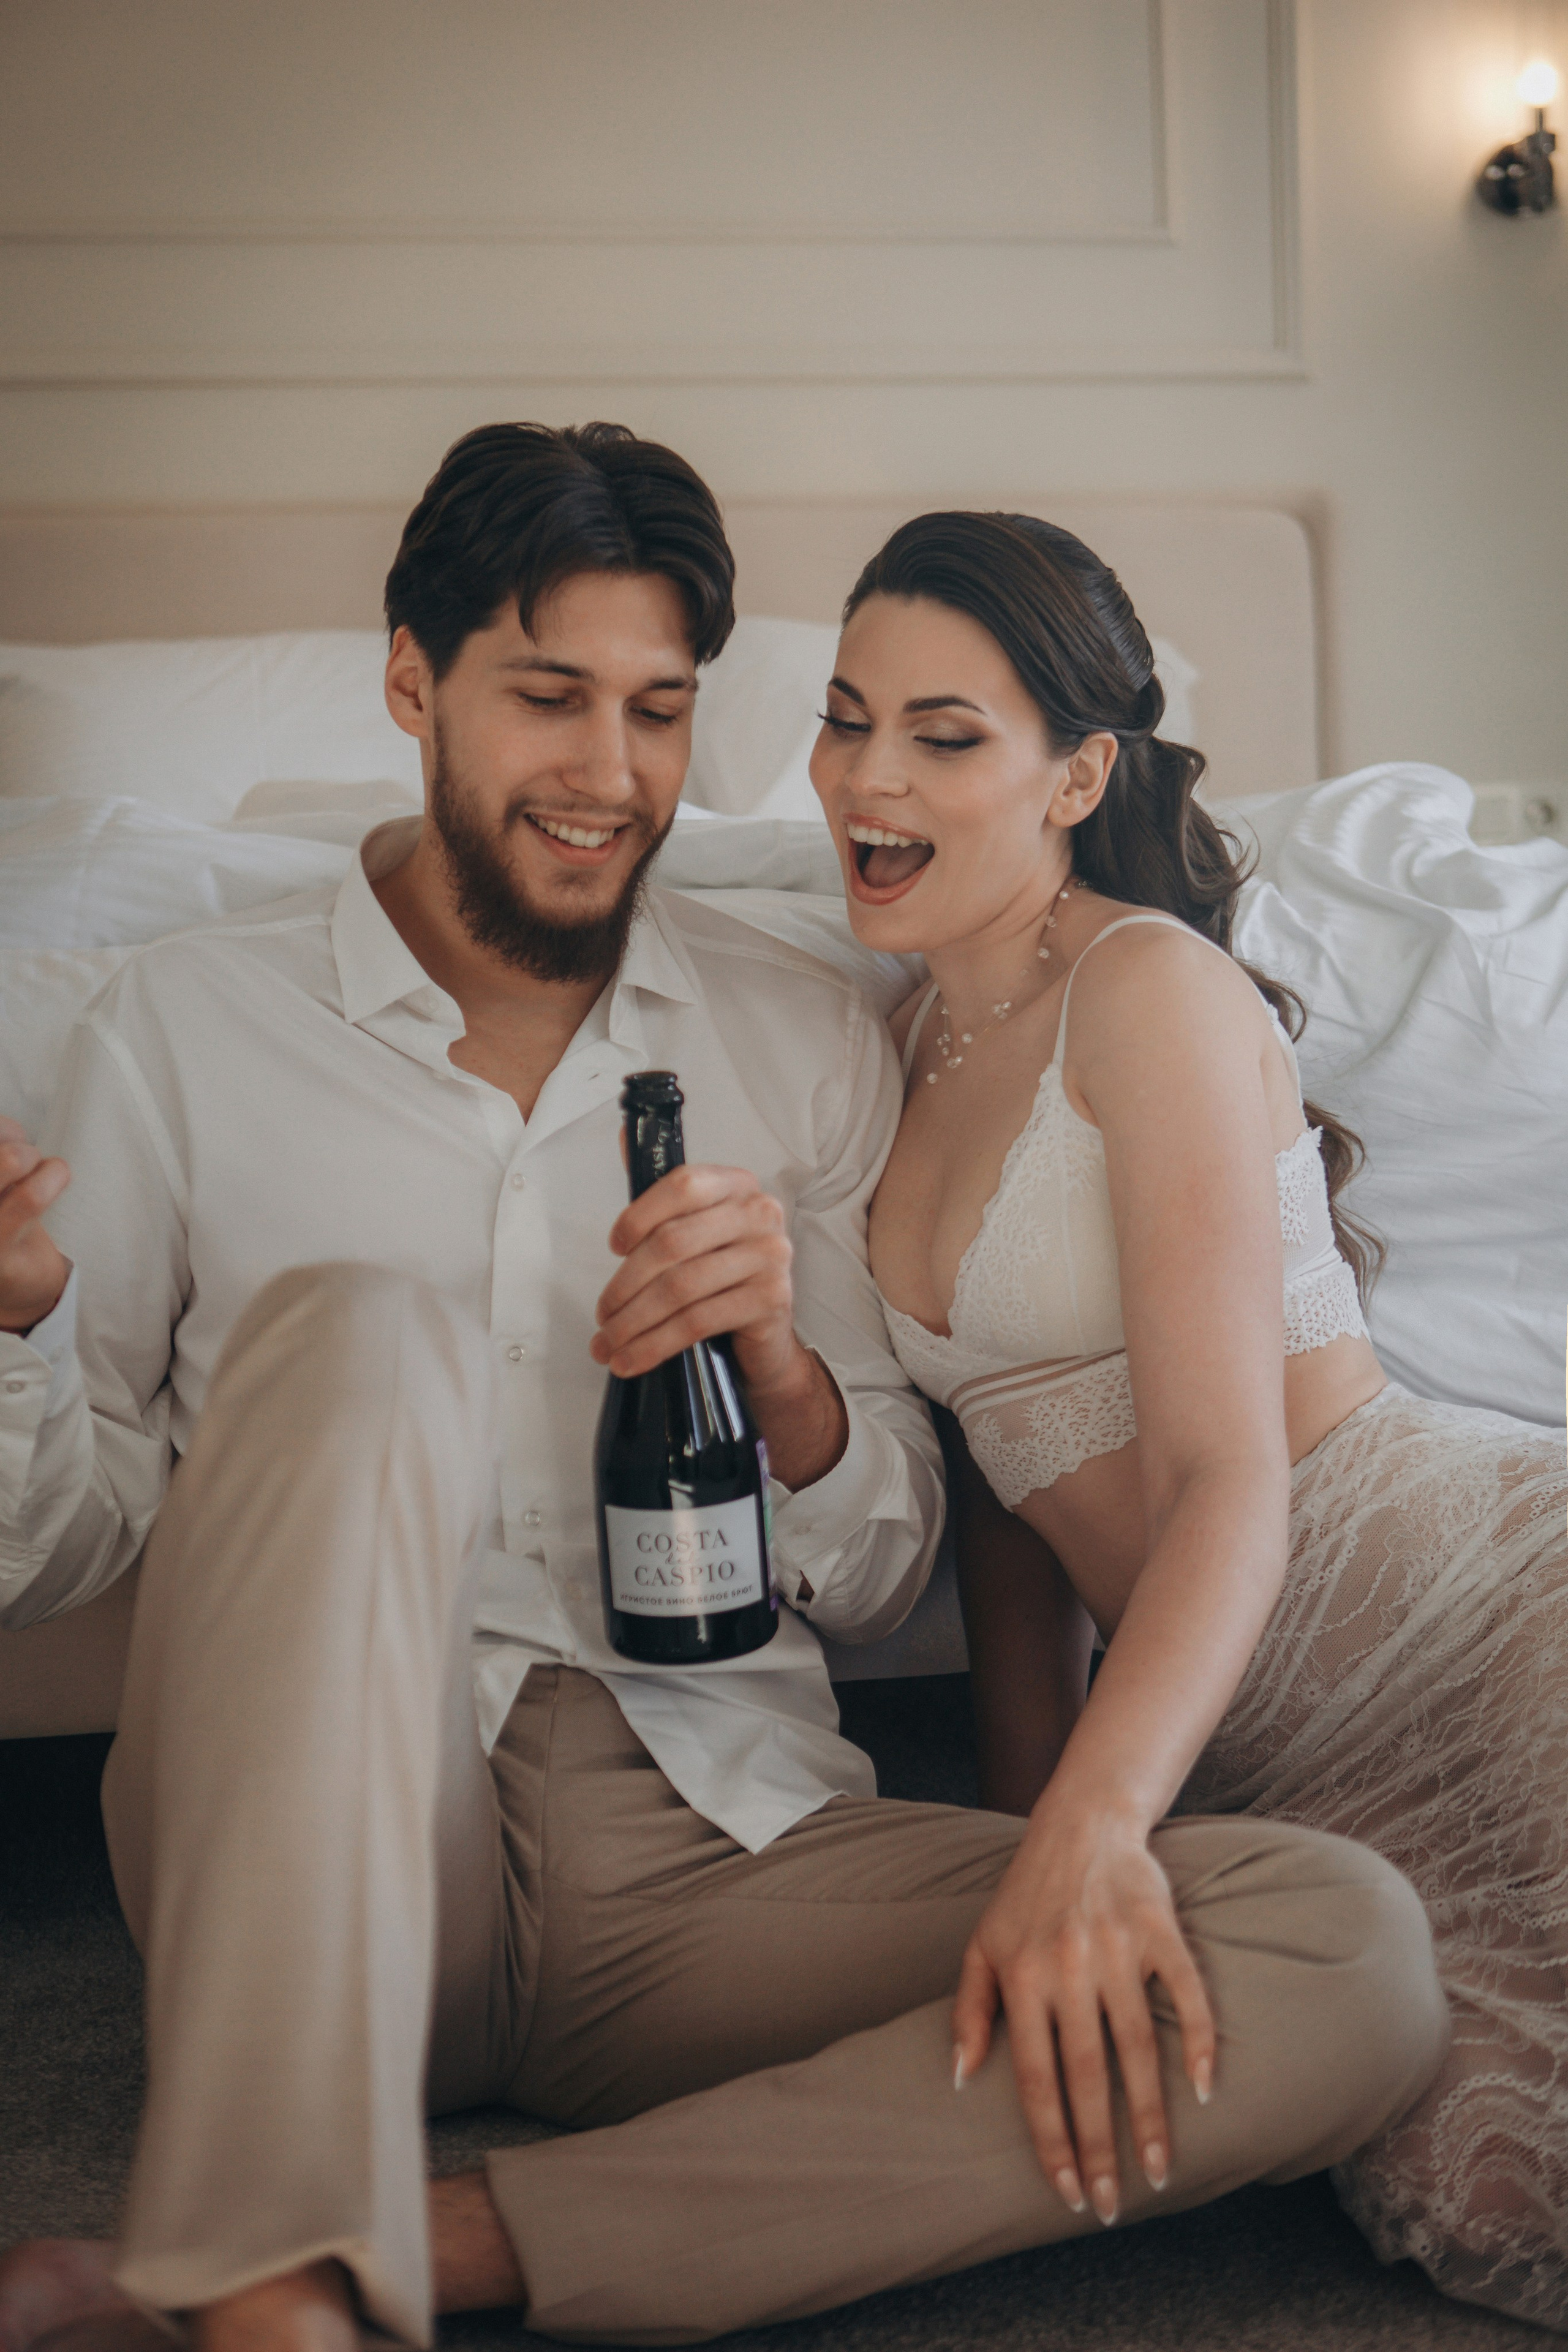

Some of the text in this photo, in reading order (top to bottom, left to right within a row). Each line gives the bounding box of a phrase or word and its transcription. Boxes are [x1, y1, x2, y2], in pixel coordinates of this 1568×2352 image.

[636, 1528, 728, 1554] COSTA
[634, 1560, 735, 1587] CASPIO
[666, 1595, 693, 1606] ВИНО
